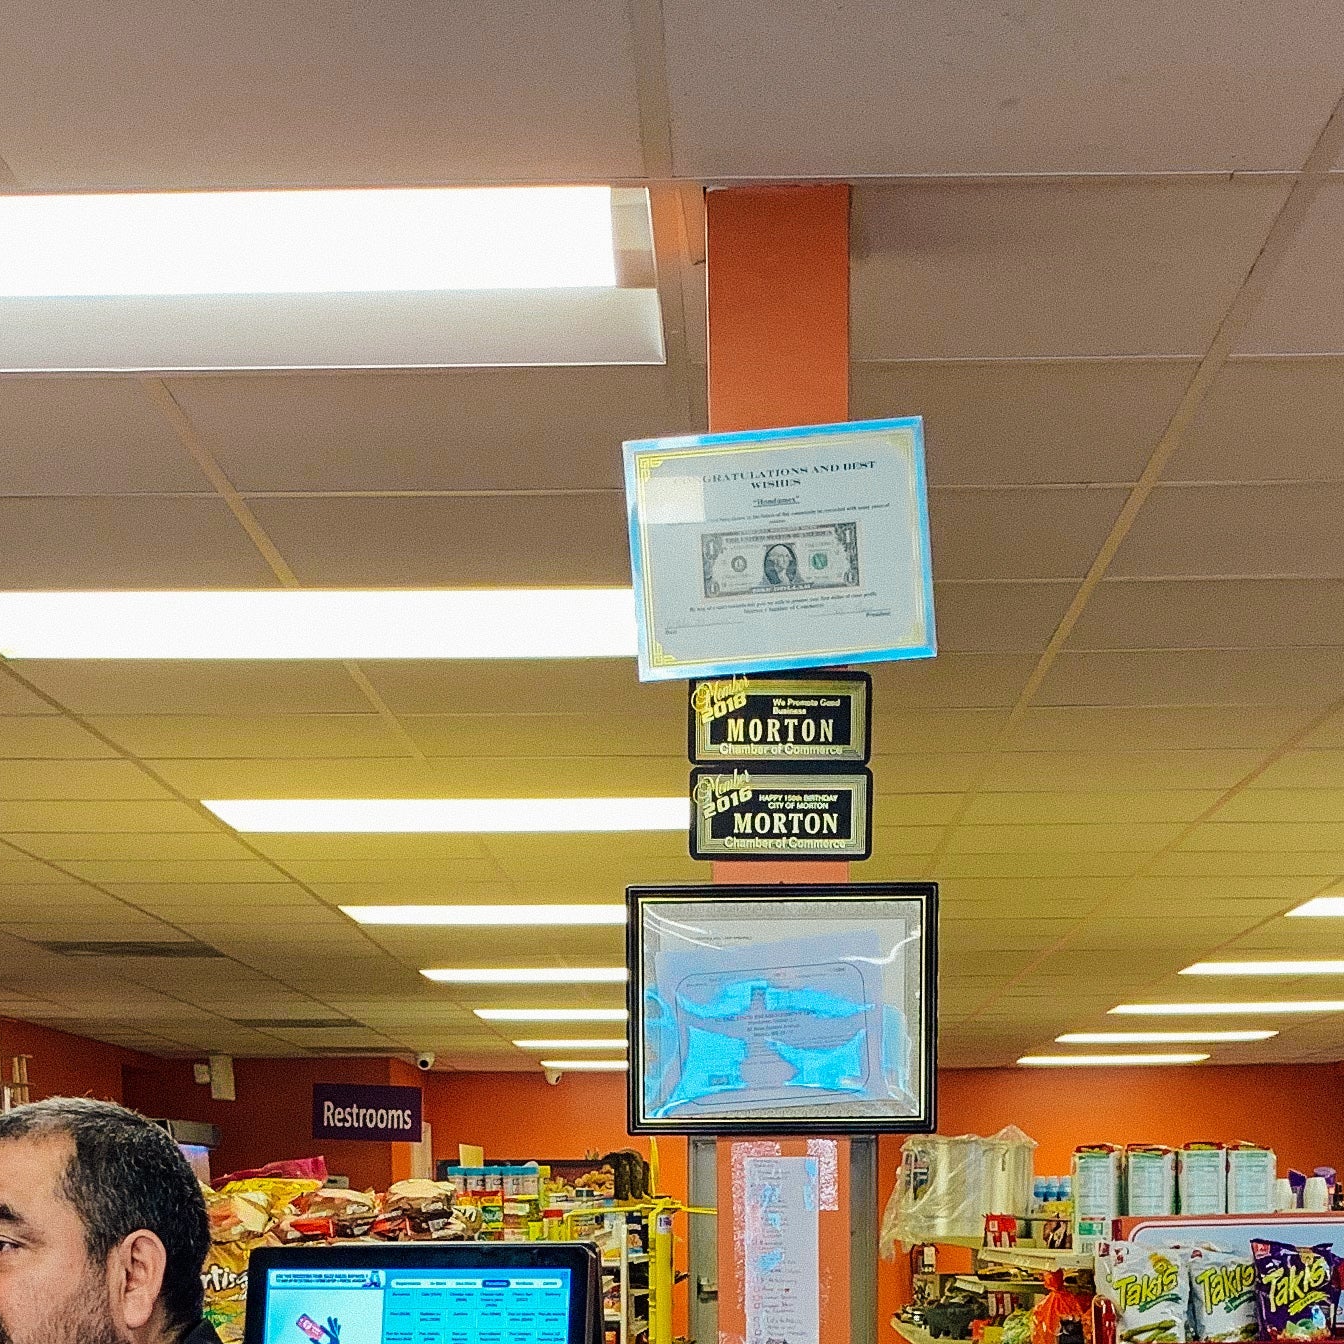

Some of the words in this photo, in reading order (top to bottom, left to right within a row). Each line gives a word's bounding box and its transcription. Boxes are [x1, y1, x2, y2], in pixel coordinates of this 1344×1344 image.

[812, 463, 840, 474] AND
[843, 460, 876, 471] BEST
[751, 479, 801, 489] WISHES
[727, 718, 834, 742] MORTON
[719, 743, 770, 755] Chamber
[771, 743, 782, 755] of
[784, 743, 843, 755] Commerce
[703, 786, 752, 819] 2016
[768, 802, 784, 810] CITY
[785, 802, 795, 810] OF
[796, 802, 829, 810] MORTON
[733, 813, 839, 834] MORTON
[724, 836, 775, 849] Chamber
[775, 837, 787, 849] of
[789, 837, 846, 849] Commerce
[323, 1101, 412, 1129] Restrooms
[1113, 1264, 1179, 1314] Takis
[1196, 1263, 1256, 1315] Takis
[1263, 1260, 1326, 1313] Takis
